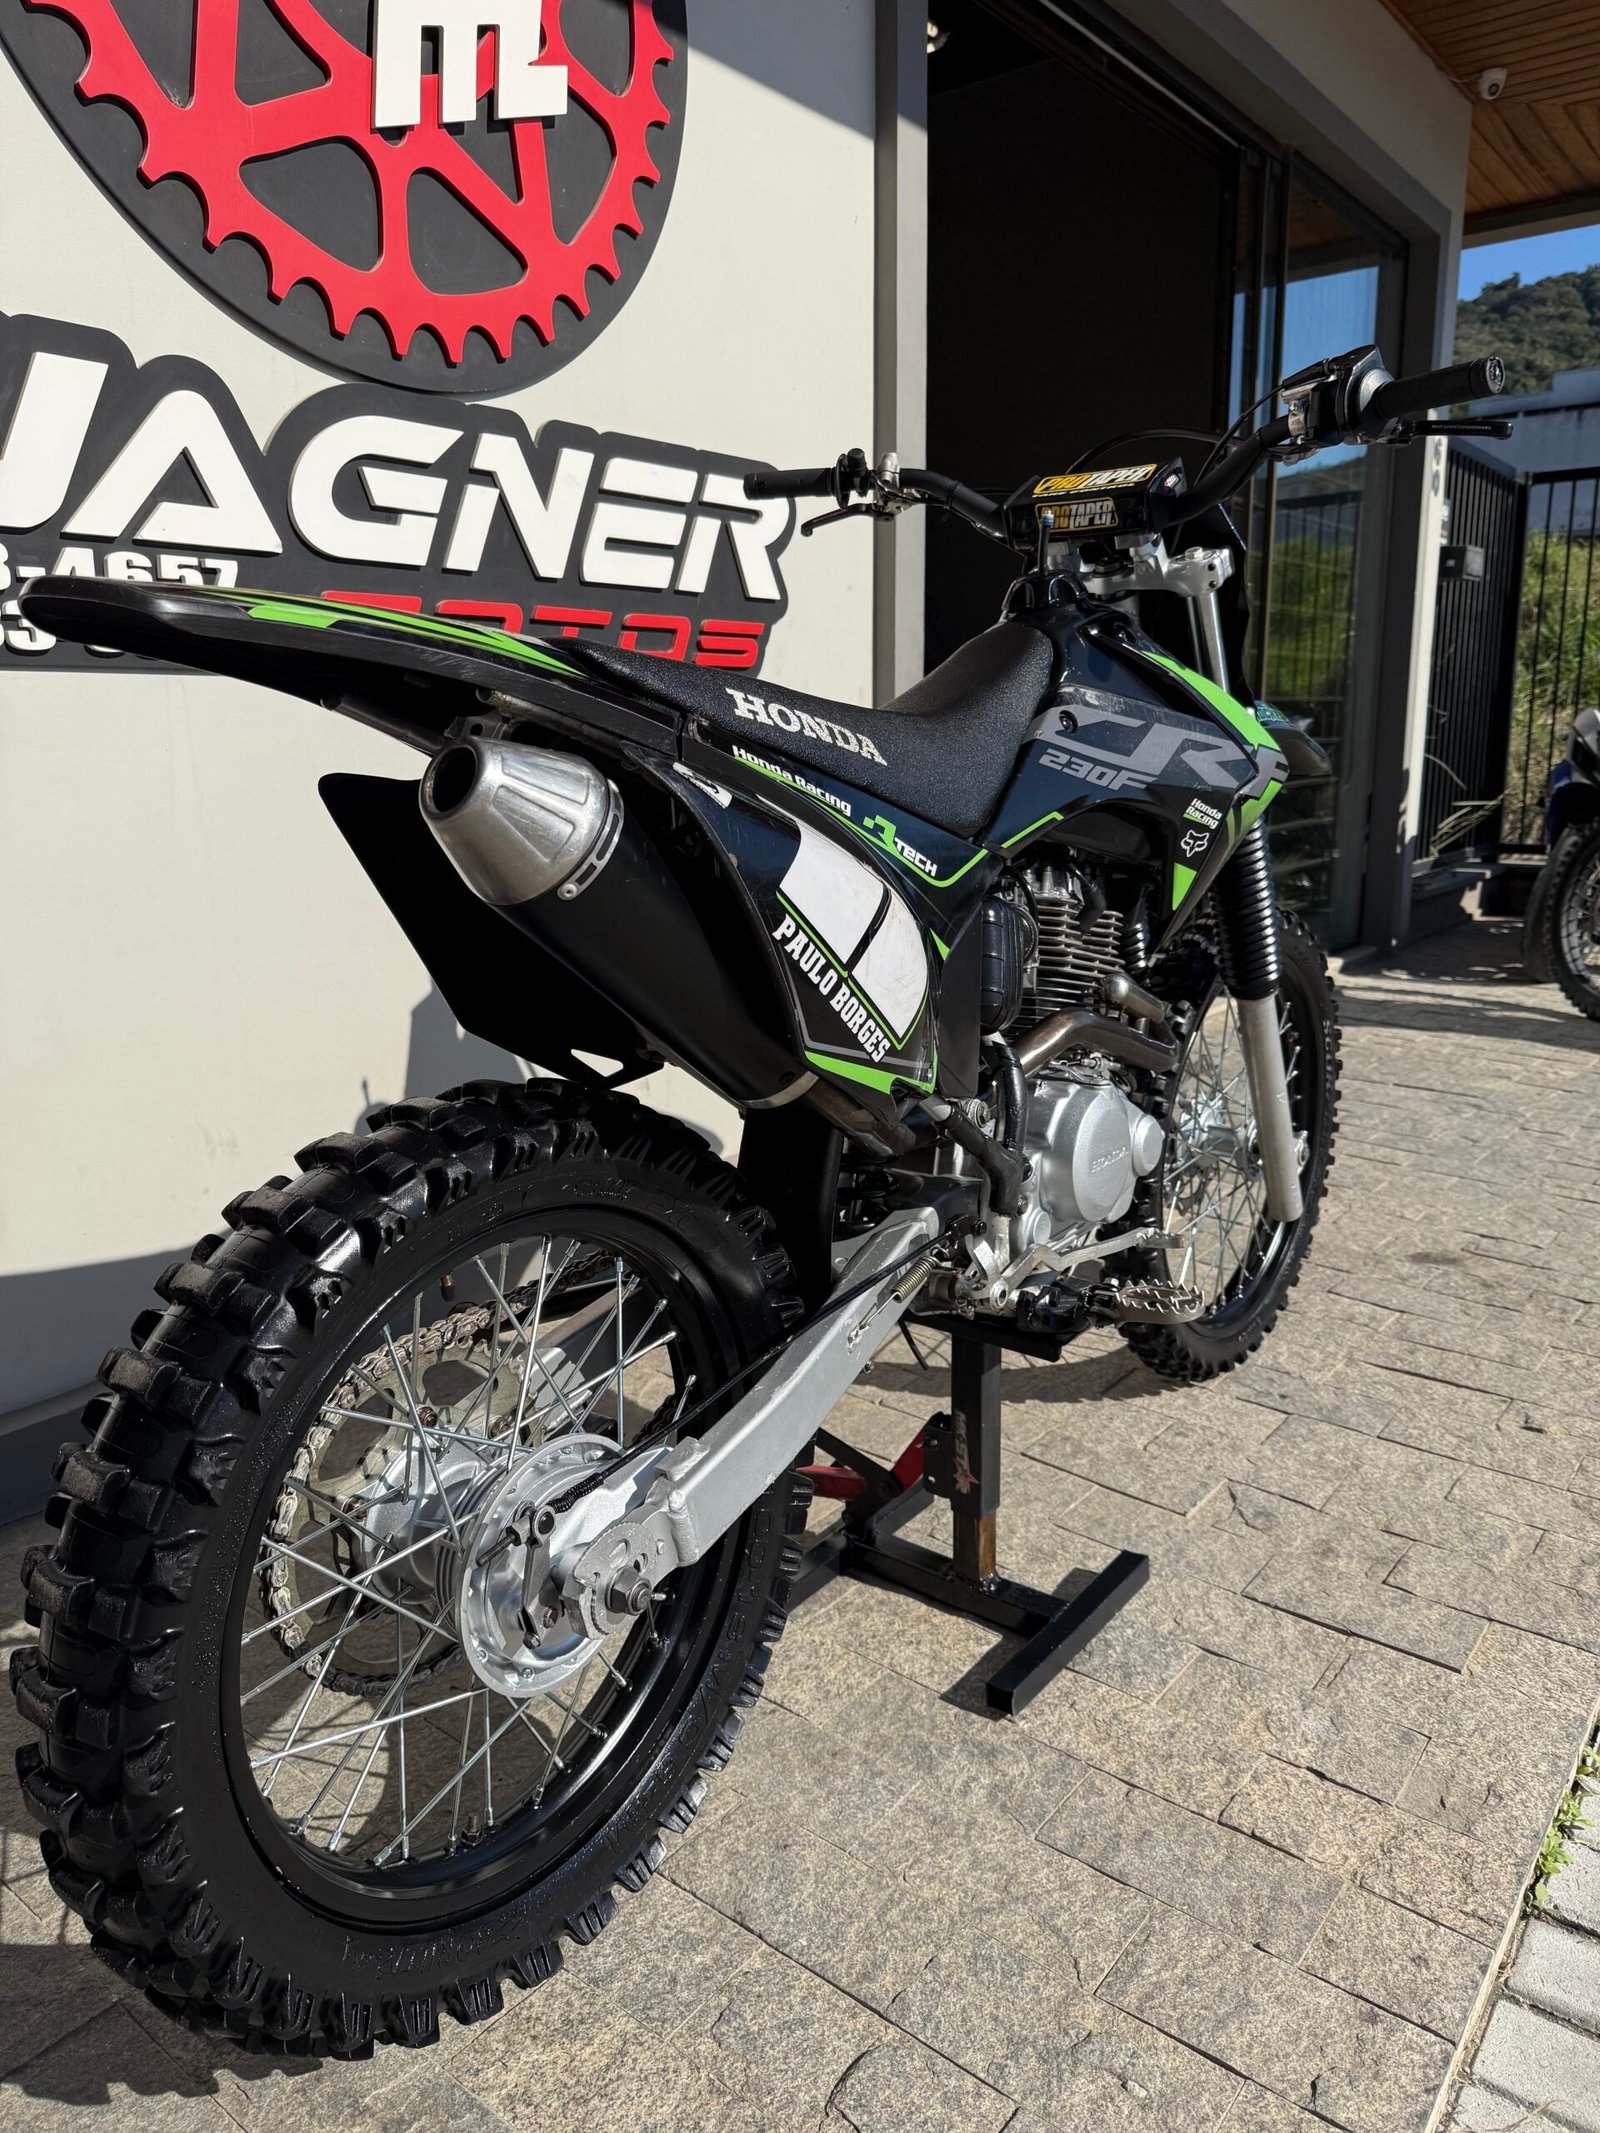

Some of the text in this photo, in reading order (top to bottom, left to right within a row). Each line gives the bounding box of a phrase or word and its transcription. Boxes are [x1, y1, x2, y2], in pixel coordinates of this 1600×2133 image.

[1041, 500, 1116, 530] ROTAPER
[0, 542, 239, 592] -4657
[725, 687, 888, 767] HONDA
[731, 745, 853, 817] Honda Racing
[1038, 748, 1160, 791] 230F
[1185, 806, 1220, 830] Racing
[1190, 798, 1223, 820] Honda
[772, 913, 889, 1064] PAULO BORGES
